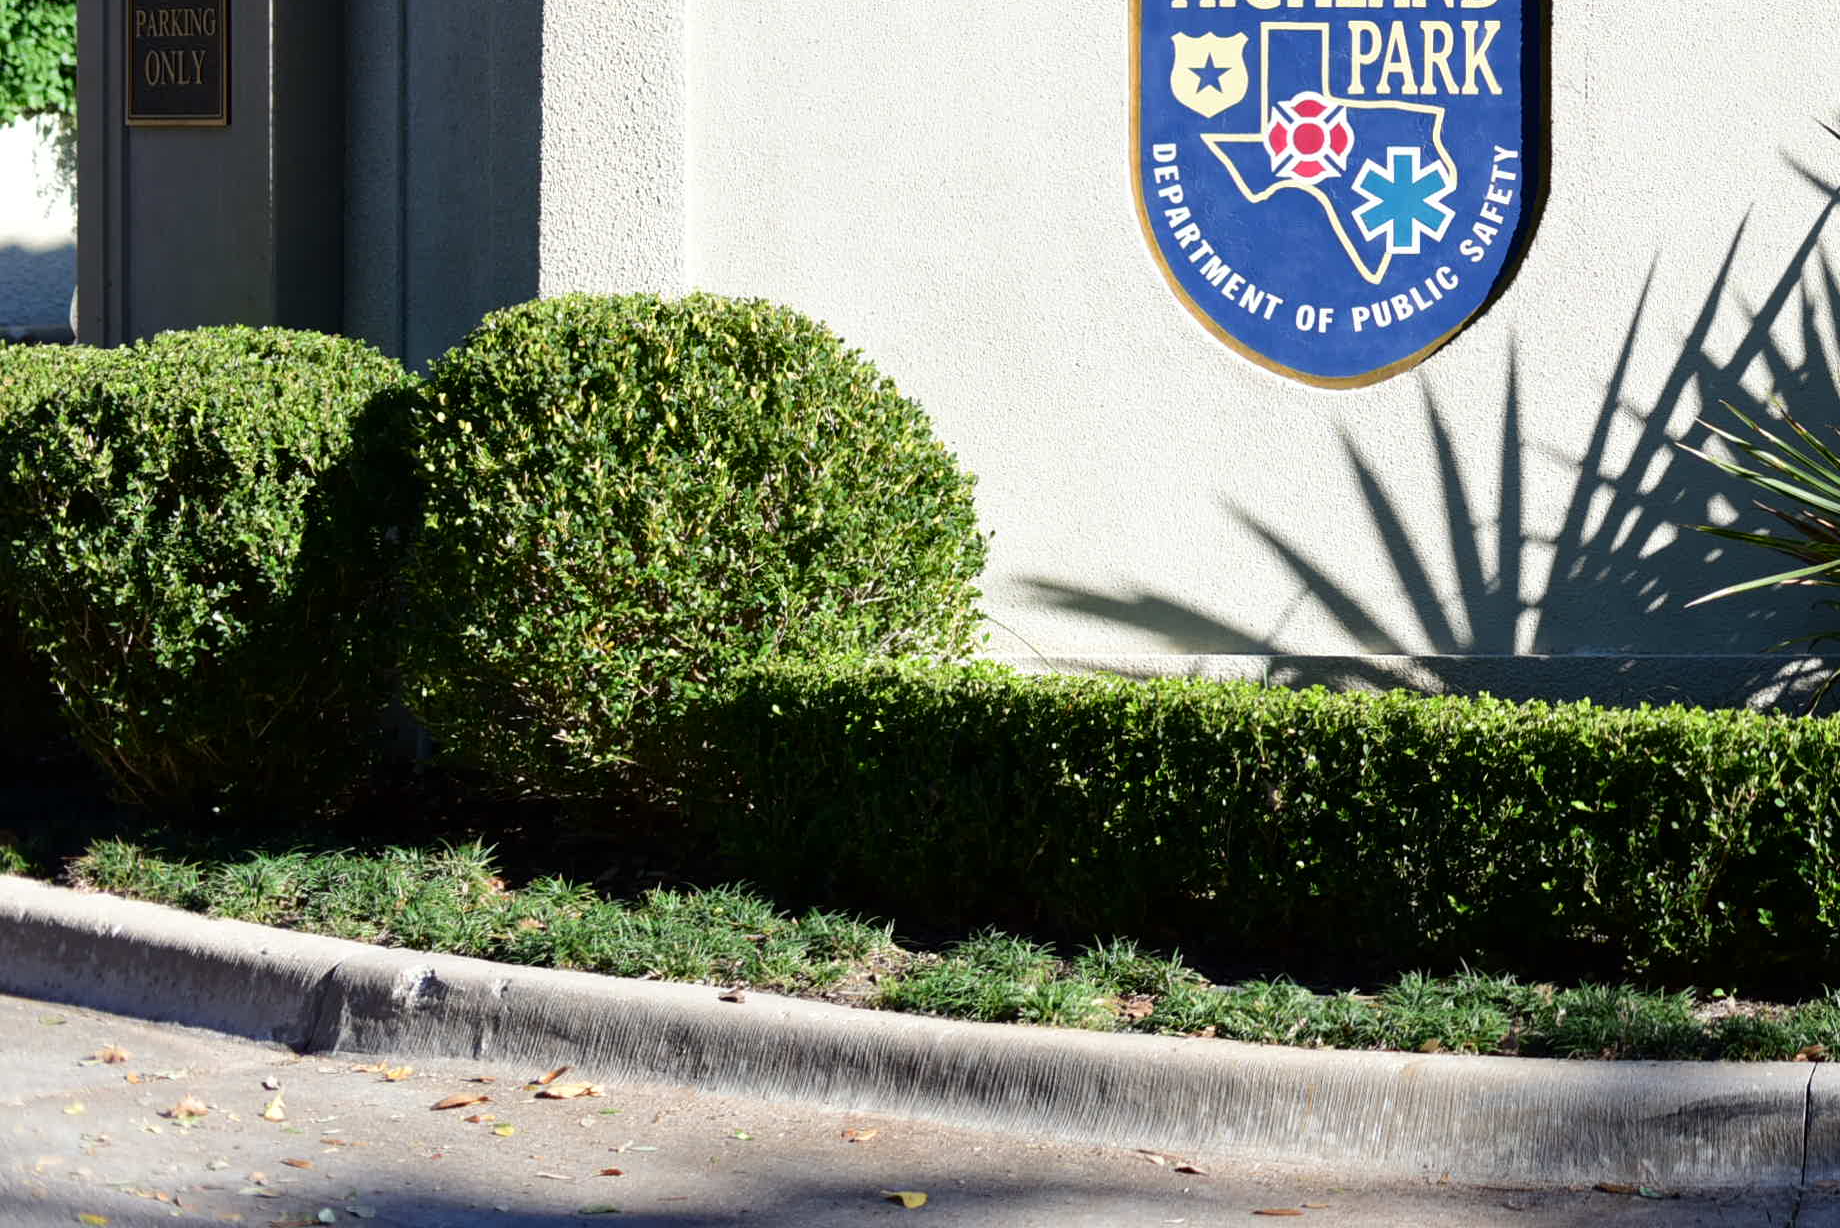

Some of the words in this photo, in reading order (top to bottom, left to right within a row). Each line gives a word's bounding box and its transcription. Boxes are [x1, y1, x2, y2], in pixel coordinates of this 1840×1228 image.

[136, 7, 216, 37] PARKING
[145, 49, 207, 86] ONLY
[1347, 20, 1503, 95] PARK
[1152, 143, 1284, 321] DEPARTMENT
[1295, 304, 1335, 333] OF
[1352, 265, 1459, 332] PUBLIC
[1460, 145, 1519, 263] SAFETY
